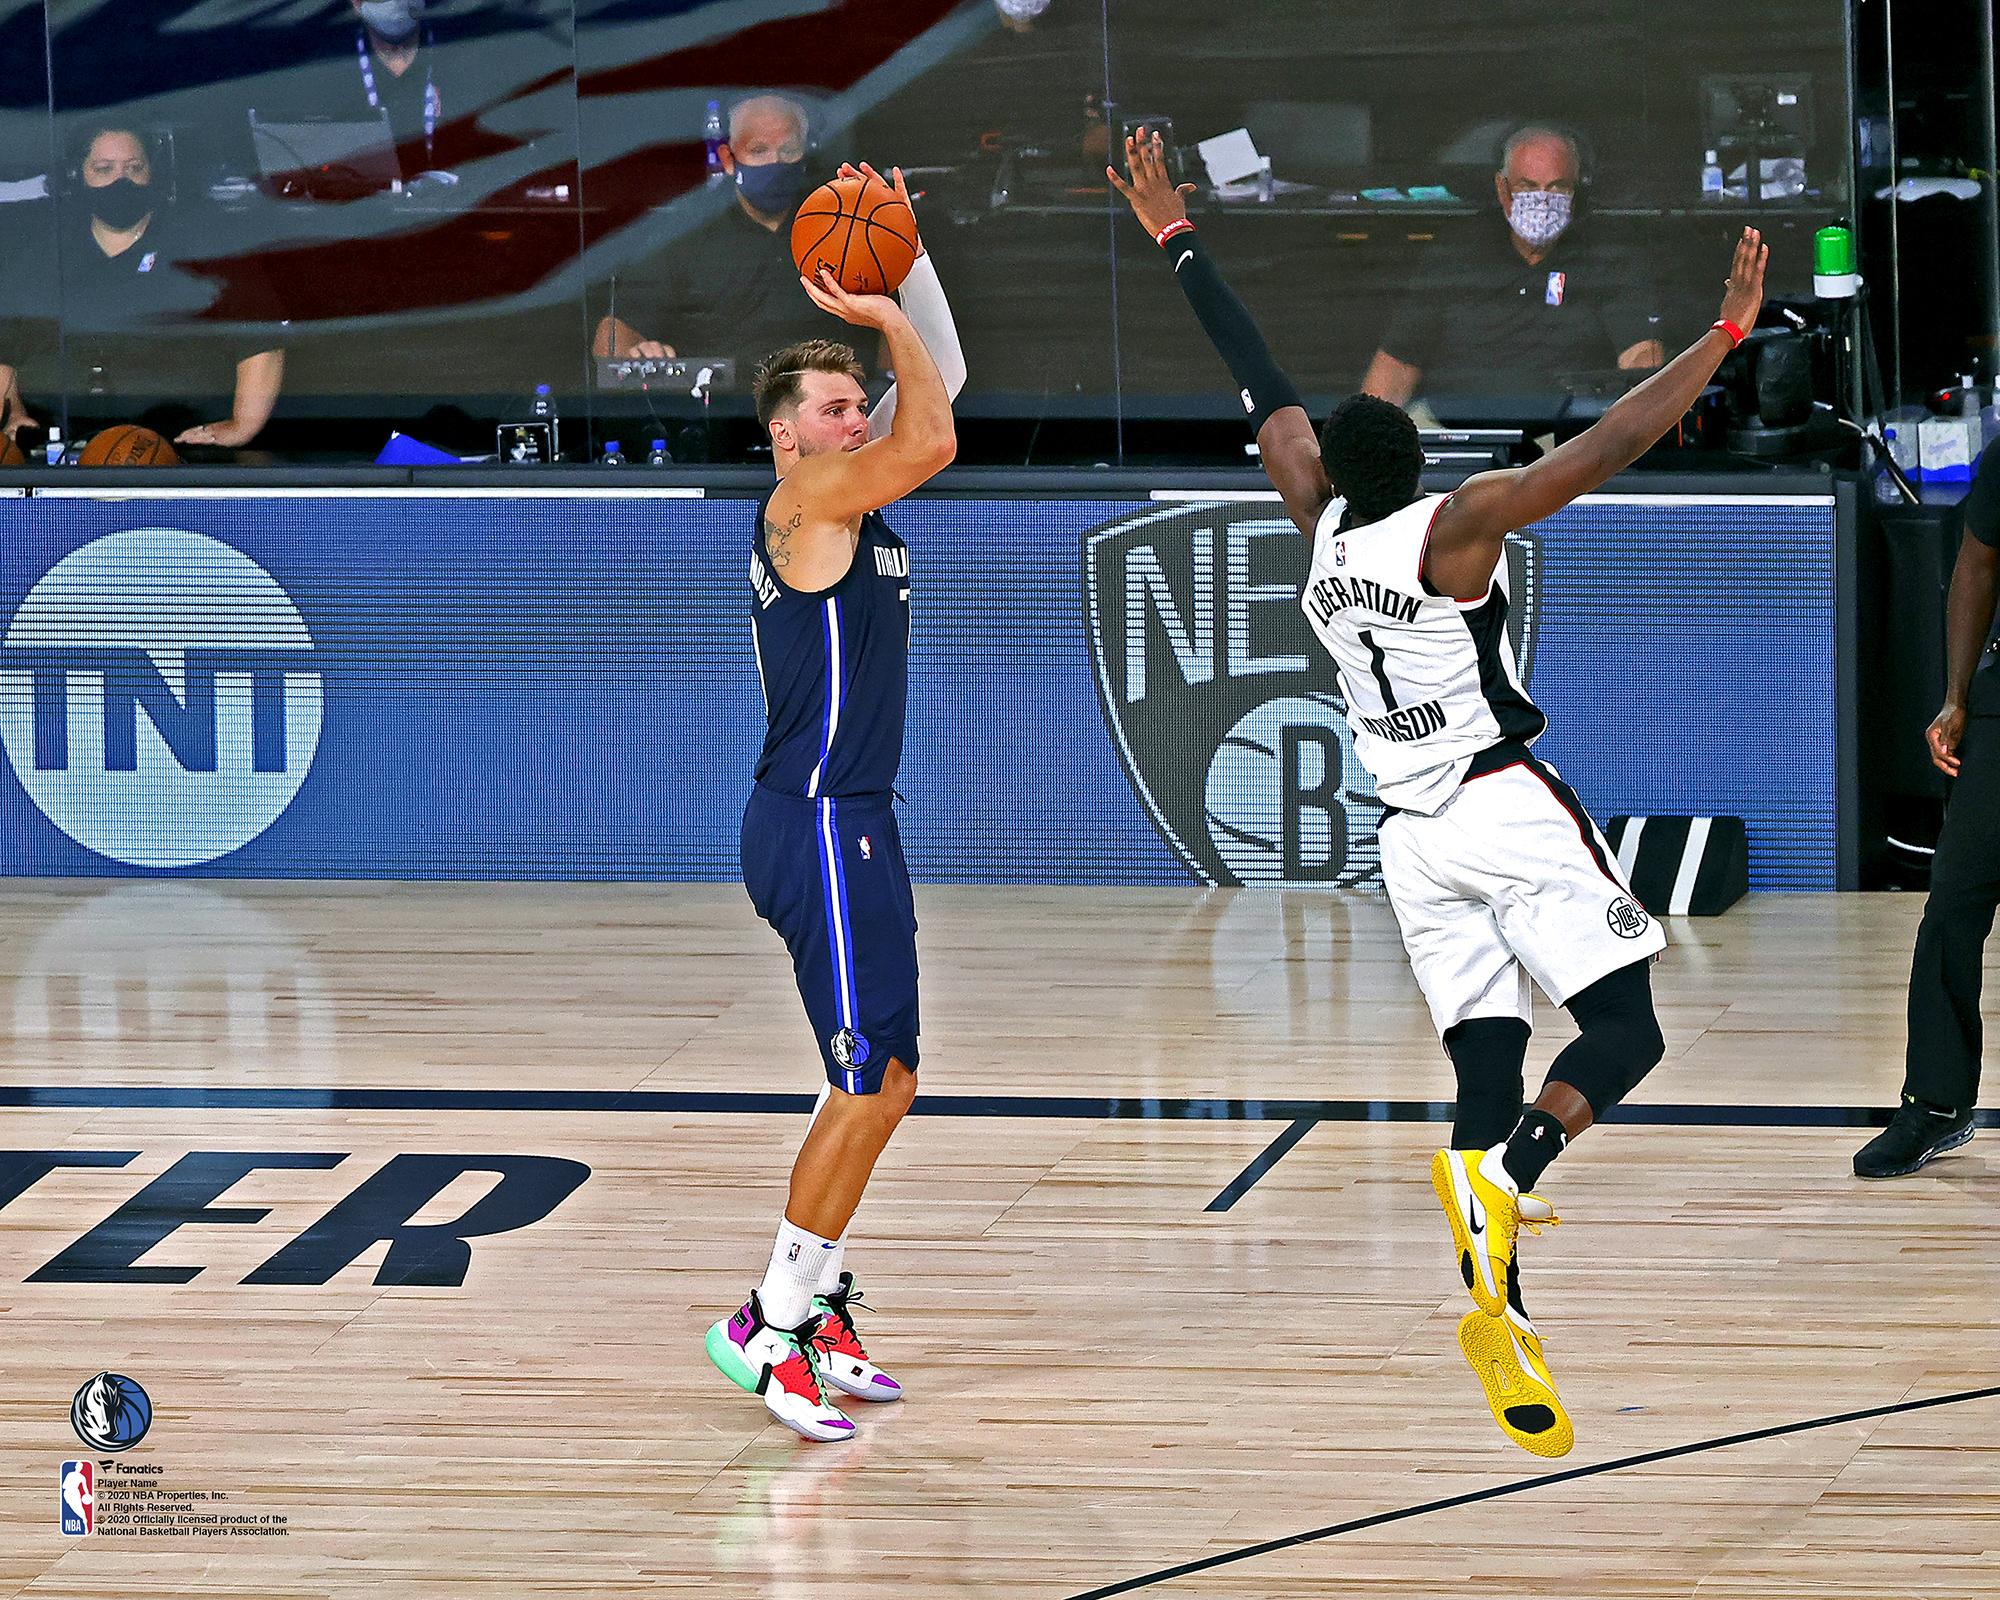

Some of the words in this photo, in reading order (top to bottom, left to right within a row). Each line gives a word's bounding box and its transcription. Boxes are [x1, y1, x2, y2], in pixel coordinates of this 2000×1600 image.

[1308, 576, 1424, 628] LBERATION
[0, 649, 319, 773] TNT
[1357, 629, 1400, 713] 1
[1282, 725, 1349, 881] B
